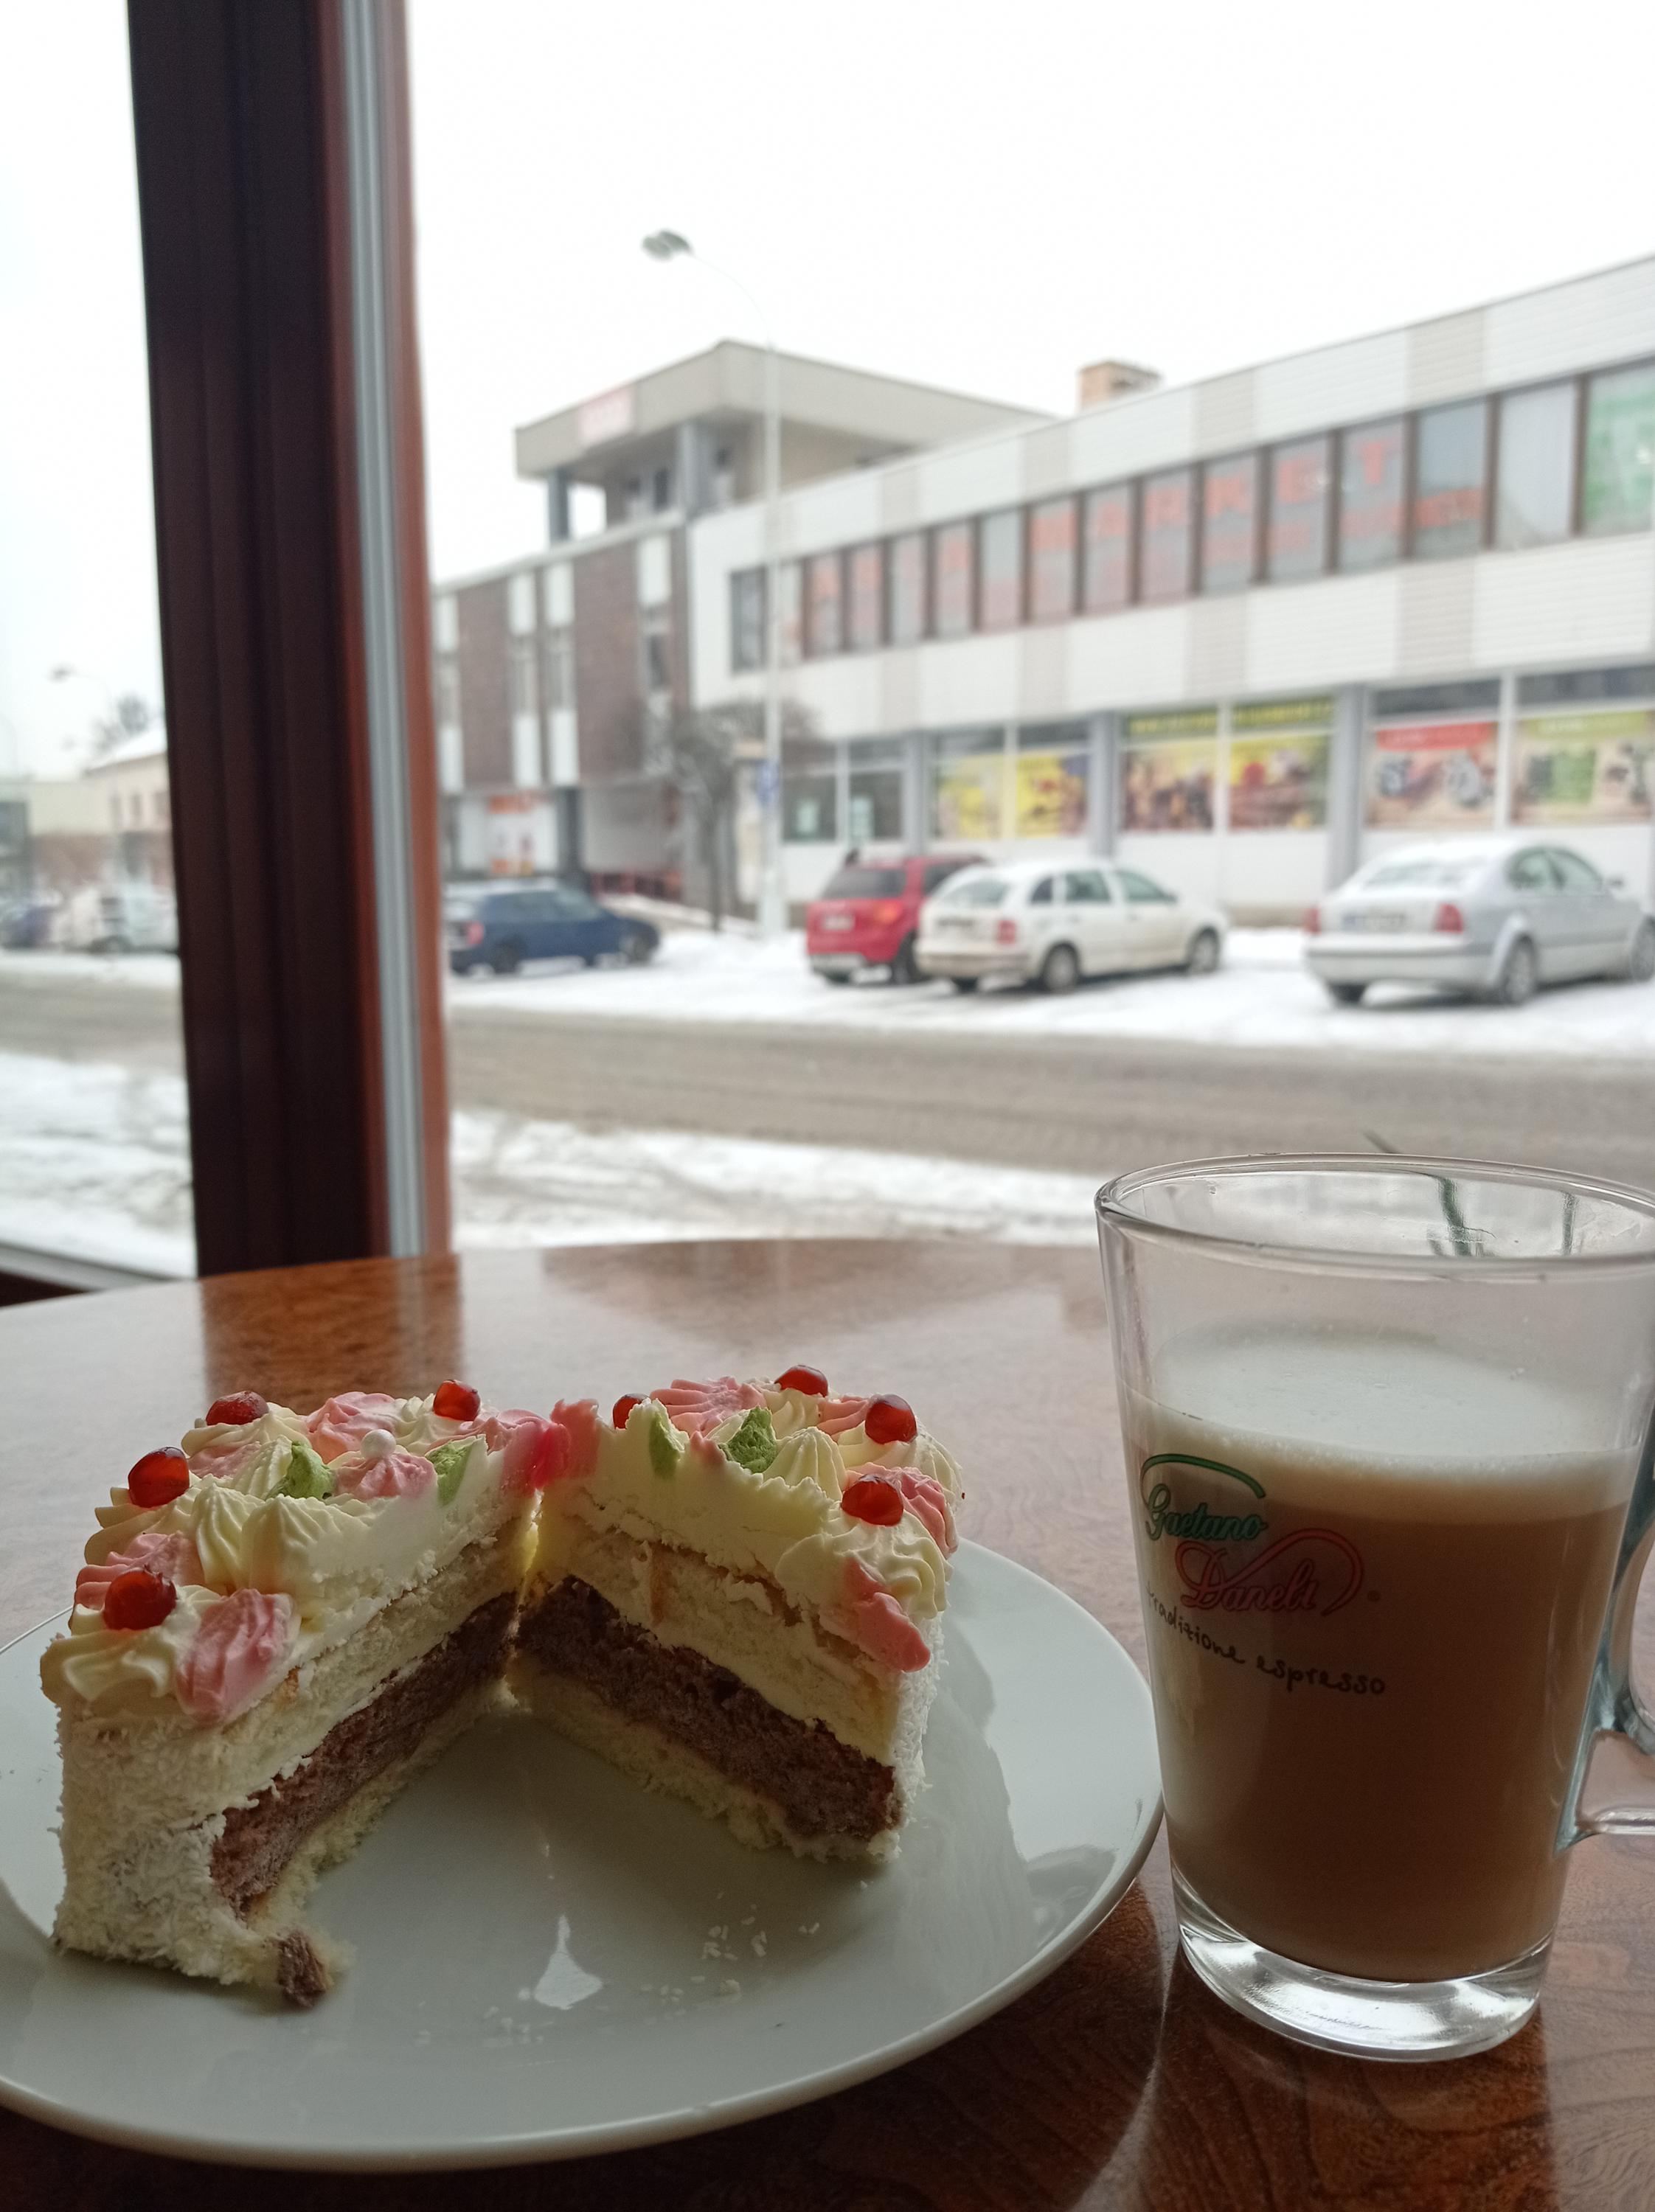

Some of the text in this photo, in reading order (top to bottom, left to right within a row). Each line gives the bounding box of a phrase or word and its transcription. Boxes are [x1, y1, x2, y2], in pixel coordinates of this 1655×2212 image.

[1141, 1454, 1268, 1540] Gaetano
[1145, 1580, 1385, 1694] tradizione espresso
